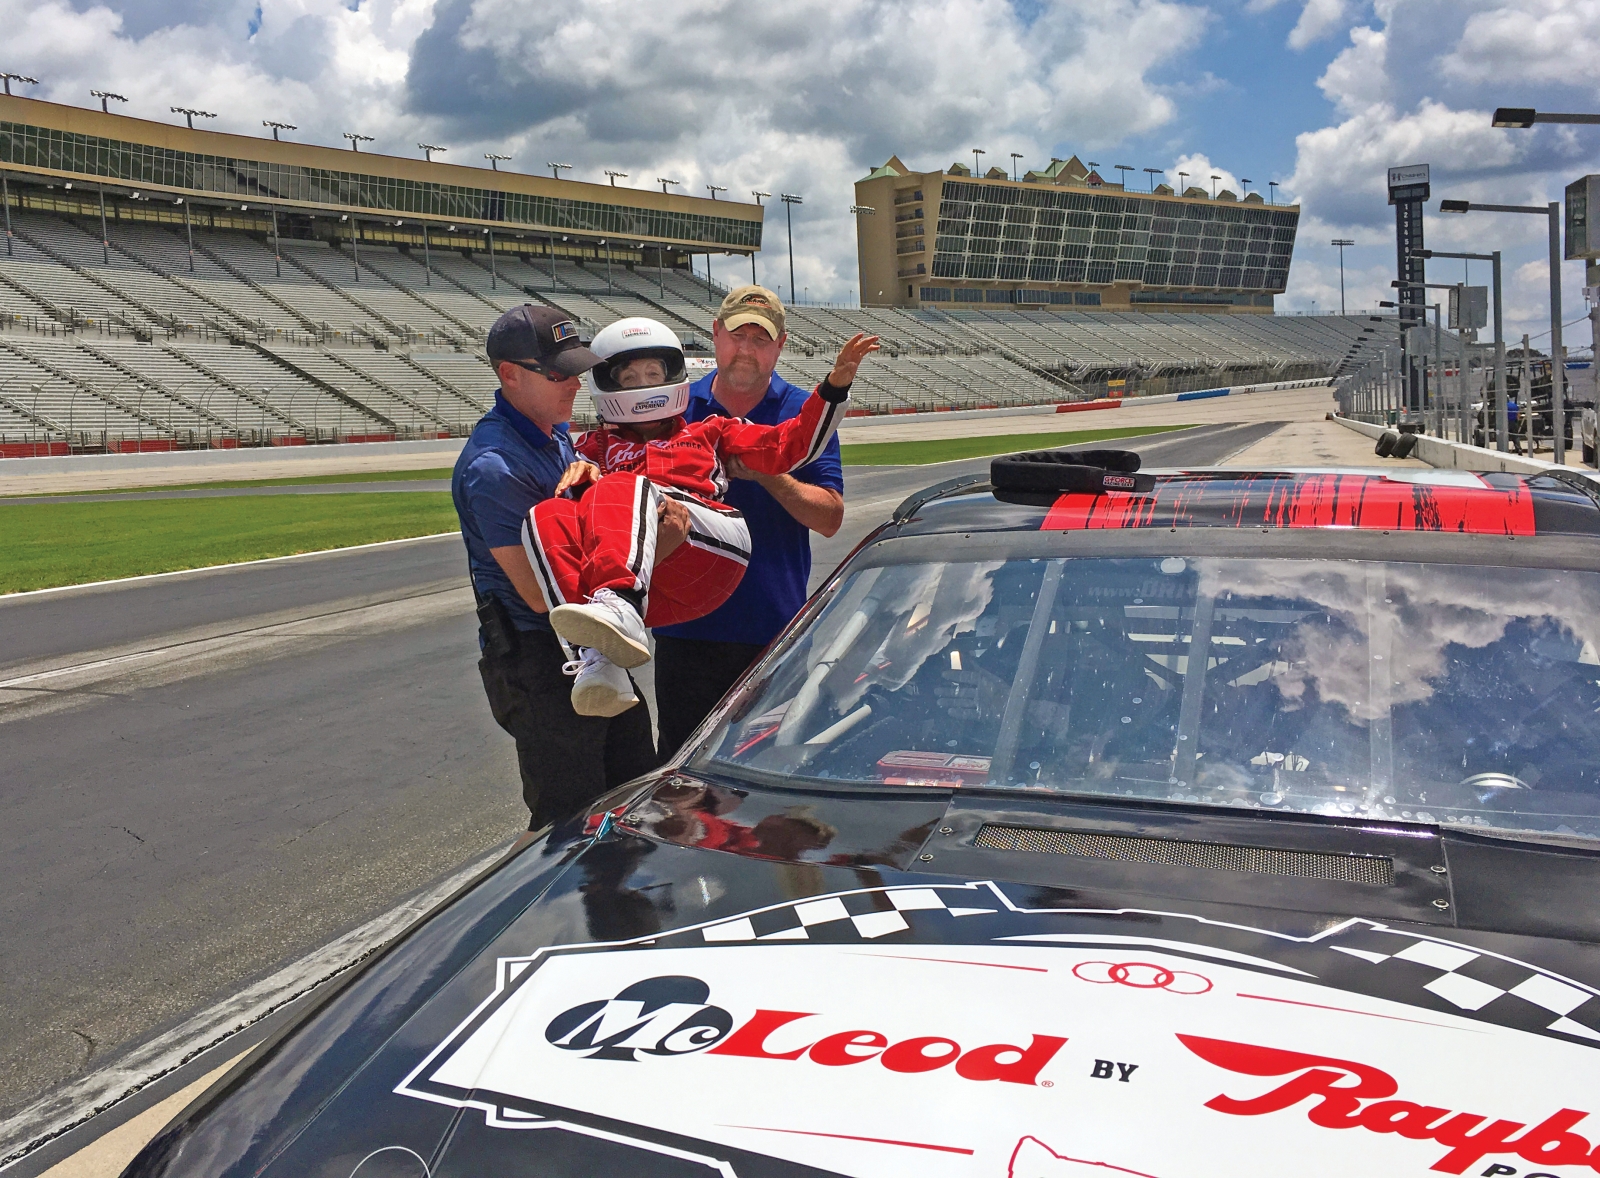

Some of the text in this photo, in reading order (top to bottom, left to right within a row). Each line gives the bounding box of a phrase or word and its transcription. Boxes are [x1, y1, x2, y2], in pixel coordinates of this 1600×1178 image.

[1403, 211, 1409, 219] 2
[1404, 238, 1410, 246] 5
[1403, 291, 1411, 299] 11
[635, 402, 666, 410] EXPERIENCE
[544, 984, 1600, 1176] McLeod BY Rayb
